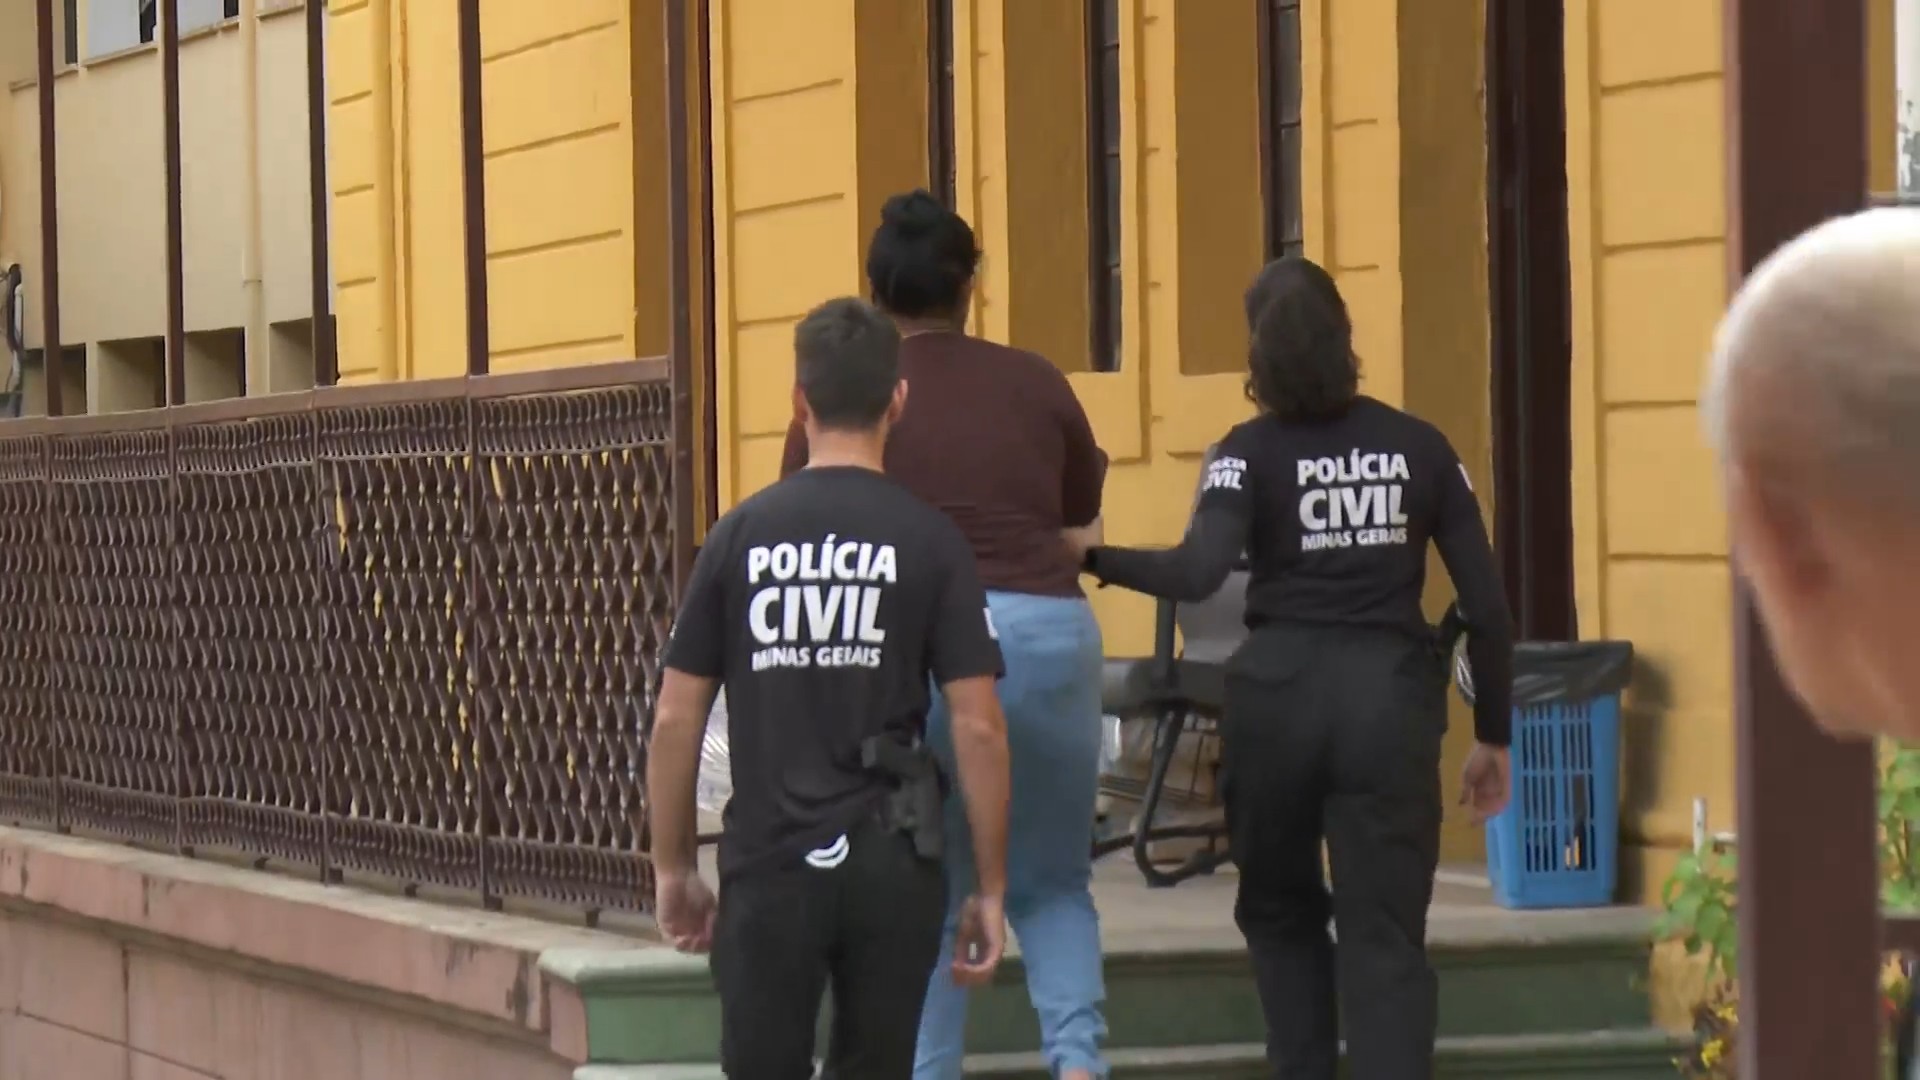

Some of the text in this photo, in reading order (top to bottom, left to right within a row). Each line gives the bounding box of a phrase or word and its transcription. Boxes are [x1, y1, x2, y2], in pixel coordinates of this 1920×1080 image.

[1297, 448, 1411, 485] POLÍCIA
[1299, 485, 1409, 531] CIVIL
[748, 534, 896, 583] POLÍCIA
[1301, 527, 1408, 551] MINAS GERAIS
[749, 585, 886, 644] CIVIL
[752, 647, 811, 671] MINAS
